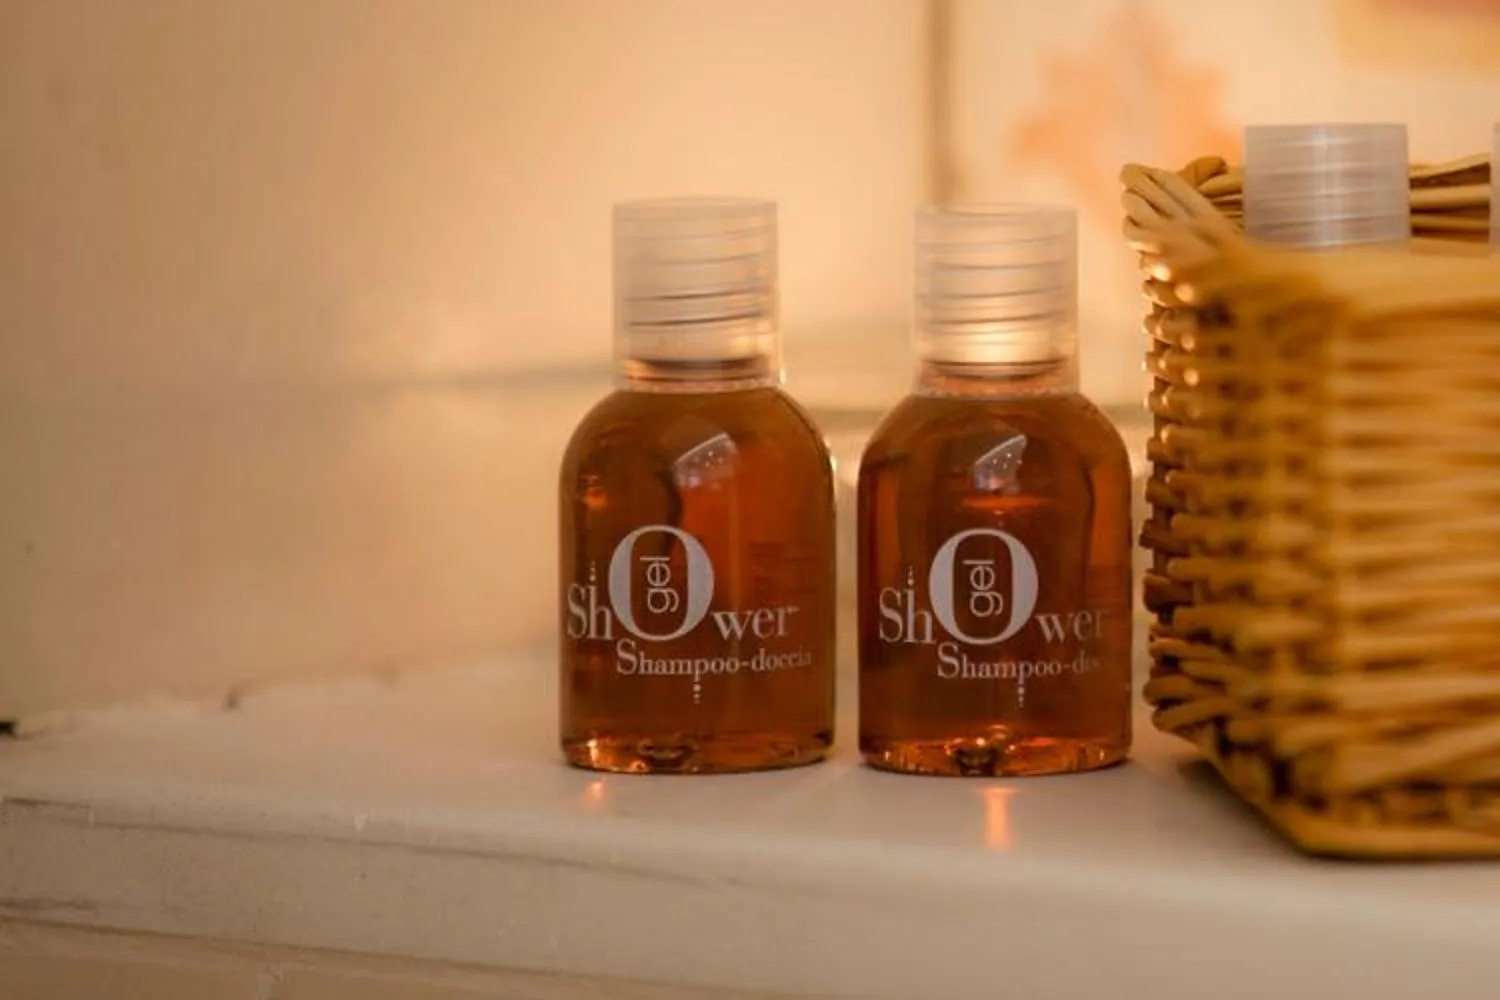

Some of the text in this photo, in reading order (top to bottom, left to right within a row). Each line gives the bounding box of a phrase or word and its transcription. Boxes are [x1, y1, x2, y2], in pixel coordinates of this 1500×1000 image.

[639, 555, 680, 614] gel
[962, 559, 1004, 618] gel
[616, 638, 812, 683] Shampoo-doccia
